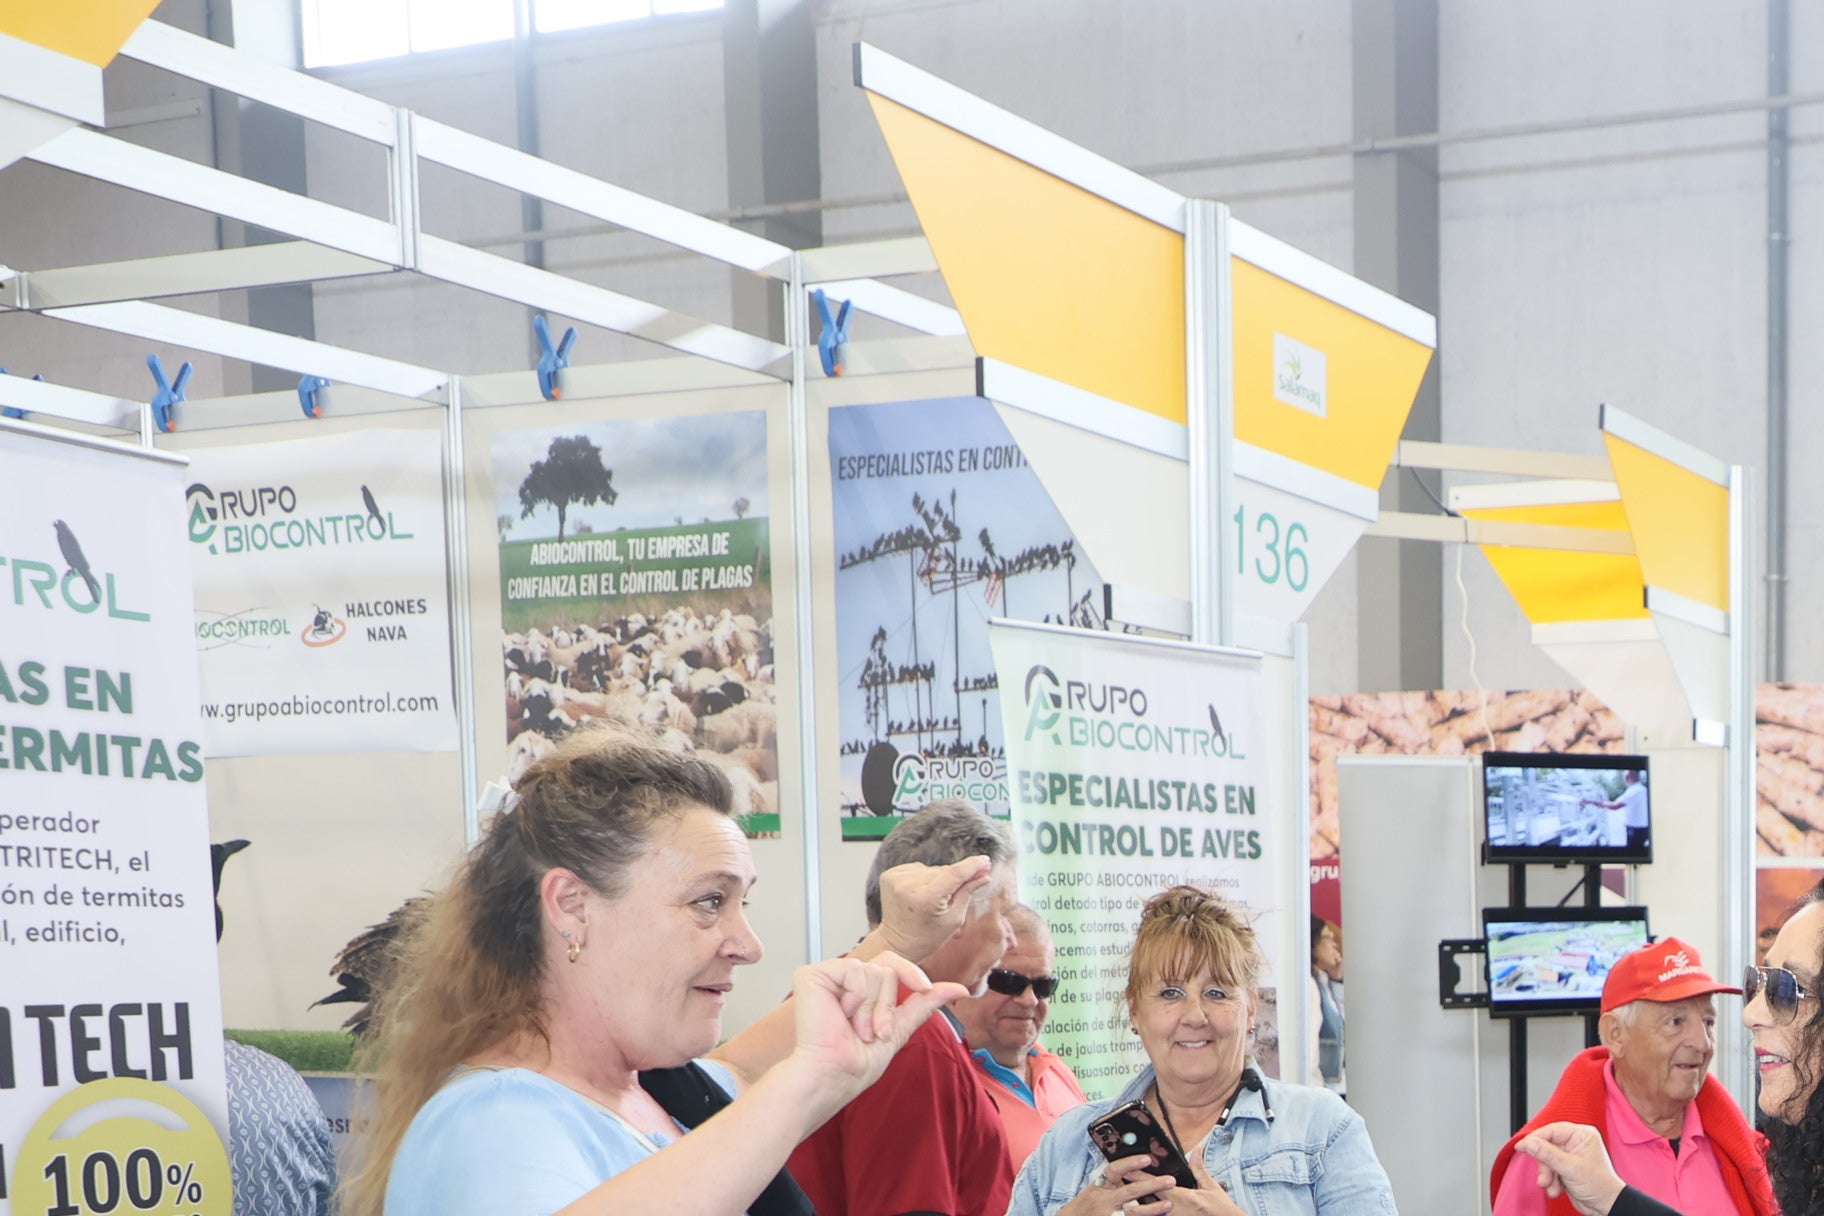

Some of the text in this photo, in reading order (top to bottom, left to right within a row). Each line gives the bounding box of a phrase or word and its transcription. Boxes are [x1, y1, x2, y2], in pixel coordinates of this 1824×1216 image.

[838, 444, 1028, 480] ESPECIALISTAS EN CONT
[530, 531, 731, 567] ABIOCONTROL, TU EMPRESA DE
[1234, 503, 1310, 592] 136
[507, 564, 753, 600] CONFIANZA EN EL CONTROL DE PLAGAS
[345, 597, 428, 619] HALCONES
[366, 625, 408, 642] NAVA
[64, 664, 134, 715] EN
[1025, 664, 1147, 717] GRUPO
[1018, 769, 1256, 815] ESPECIALISTAS EN
[1021, 819, 1263, 860] CONTROL DE AVES
[0, 844, 150, 875] TRITECH, el
[1047, 871, 1094, 887] GRUPO
[1097, 872, 1180, 888] ABIOCONTROL
[44, 883, 74, 906] de
[82, 886, 186, 909] termitas
[1055, 895, 1098, 911] detodo
[1100, 895, 1123, 914] tipo
[1126, 894, 1140, 909] de
[26, 920, 125, 947] edificio,
[1080, 964, 1097, 979] del
[1060, 988, 1077, 1004] de
[1080, 993, 1092, 1002] su
[1091, 1017, 1105, 1031] de
[1057, 1042, 1073, 1057] de
[1076, 1040, 1107, 1059] jaulas
